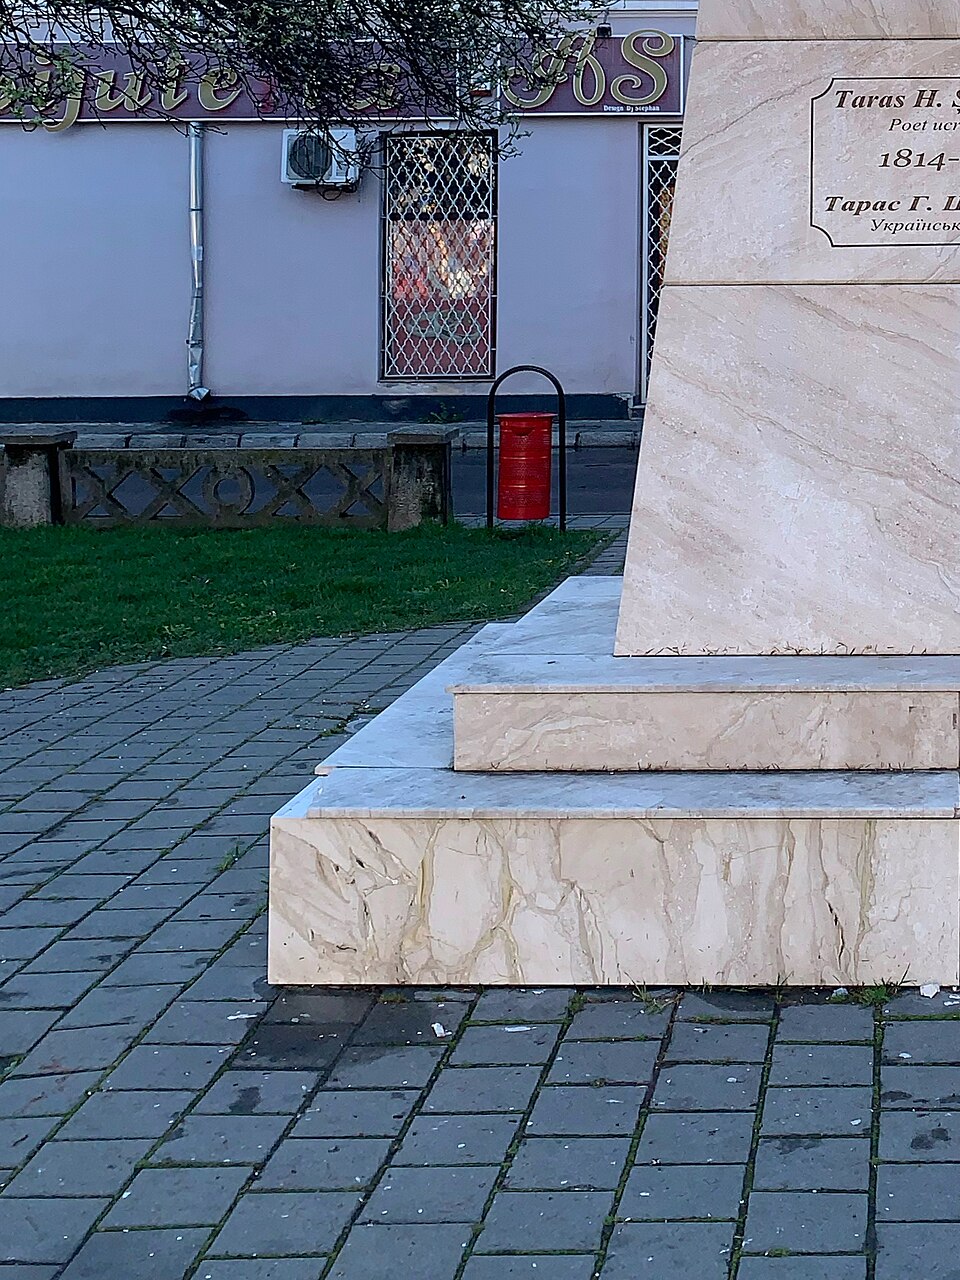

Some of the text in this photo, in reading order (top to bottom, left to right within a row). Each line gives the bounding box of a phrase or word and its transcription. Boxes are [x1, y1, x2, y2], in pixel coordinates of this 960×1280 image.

[835, 90, 906, 109] Taras
[913, 89, 942, 108] H.
[888, 118, 928, 132] Poet
[825, 196, 901, 216] Тарас
[908, 195, 932, 211] Г.
